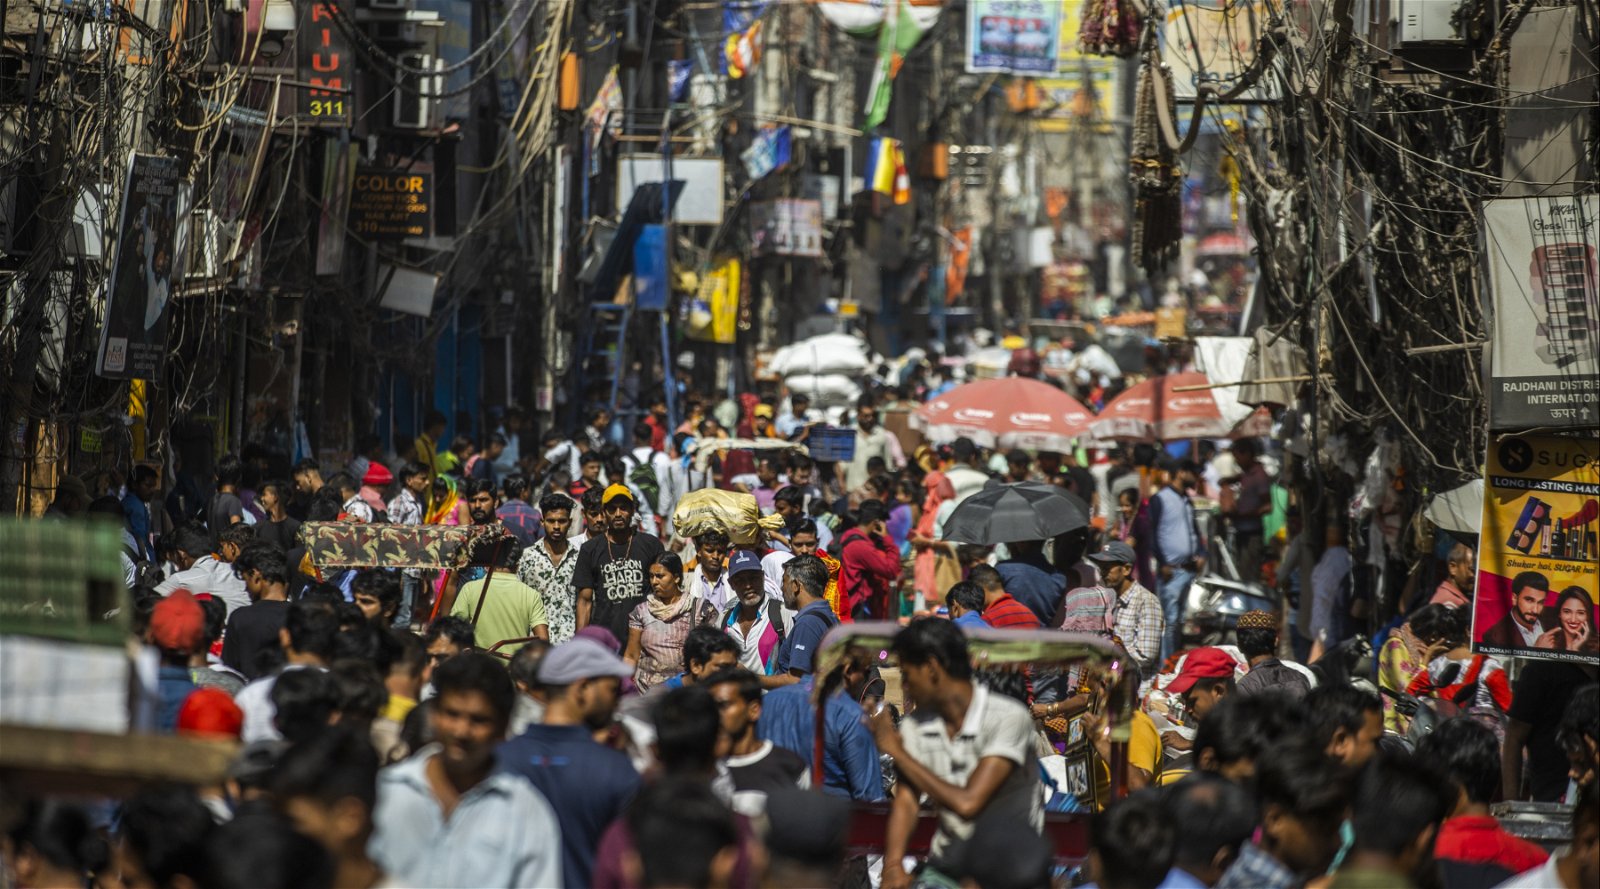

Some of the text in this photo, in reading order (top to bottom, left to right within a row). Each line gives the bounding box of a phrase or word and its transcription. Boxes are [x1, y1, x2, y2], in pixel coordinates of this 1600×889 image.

[310, 100, 343, 116] 311
[355, 175, 424, 193] COLOR
[361, 193, 418, 204] COSMETICS
[354, 220, 378, 233] 310
[1503, 381, 1557, 392] RAJDHANI
[1549, 408, 1577, 419] ऊपर
[1495, 477, 1525, 488] LONG
[1527, 481, 1573, 492] LASTING
[1553, 563, 1583, 573] SUGAR
[605, 569, 644, 586] HARD
[606, 582, 643, 600] CORE
[1479, 646, 1512, 654] RAJDHANI
[1513, 650, 1558, 659] DISTRIBUTORS
